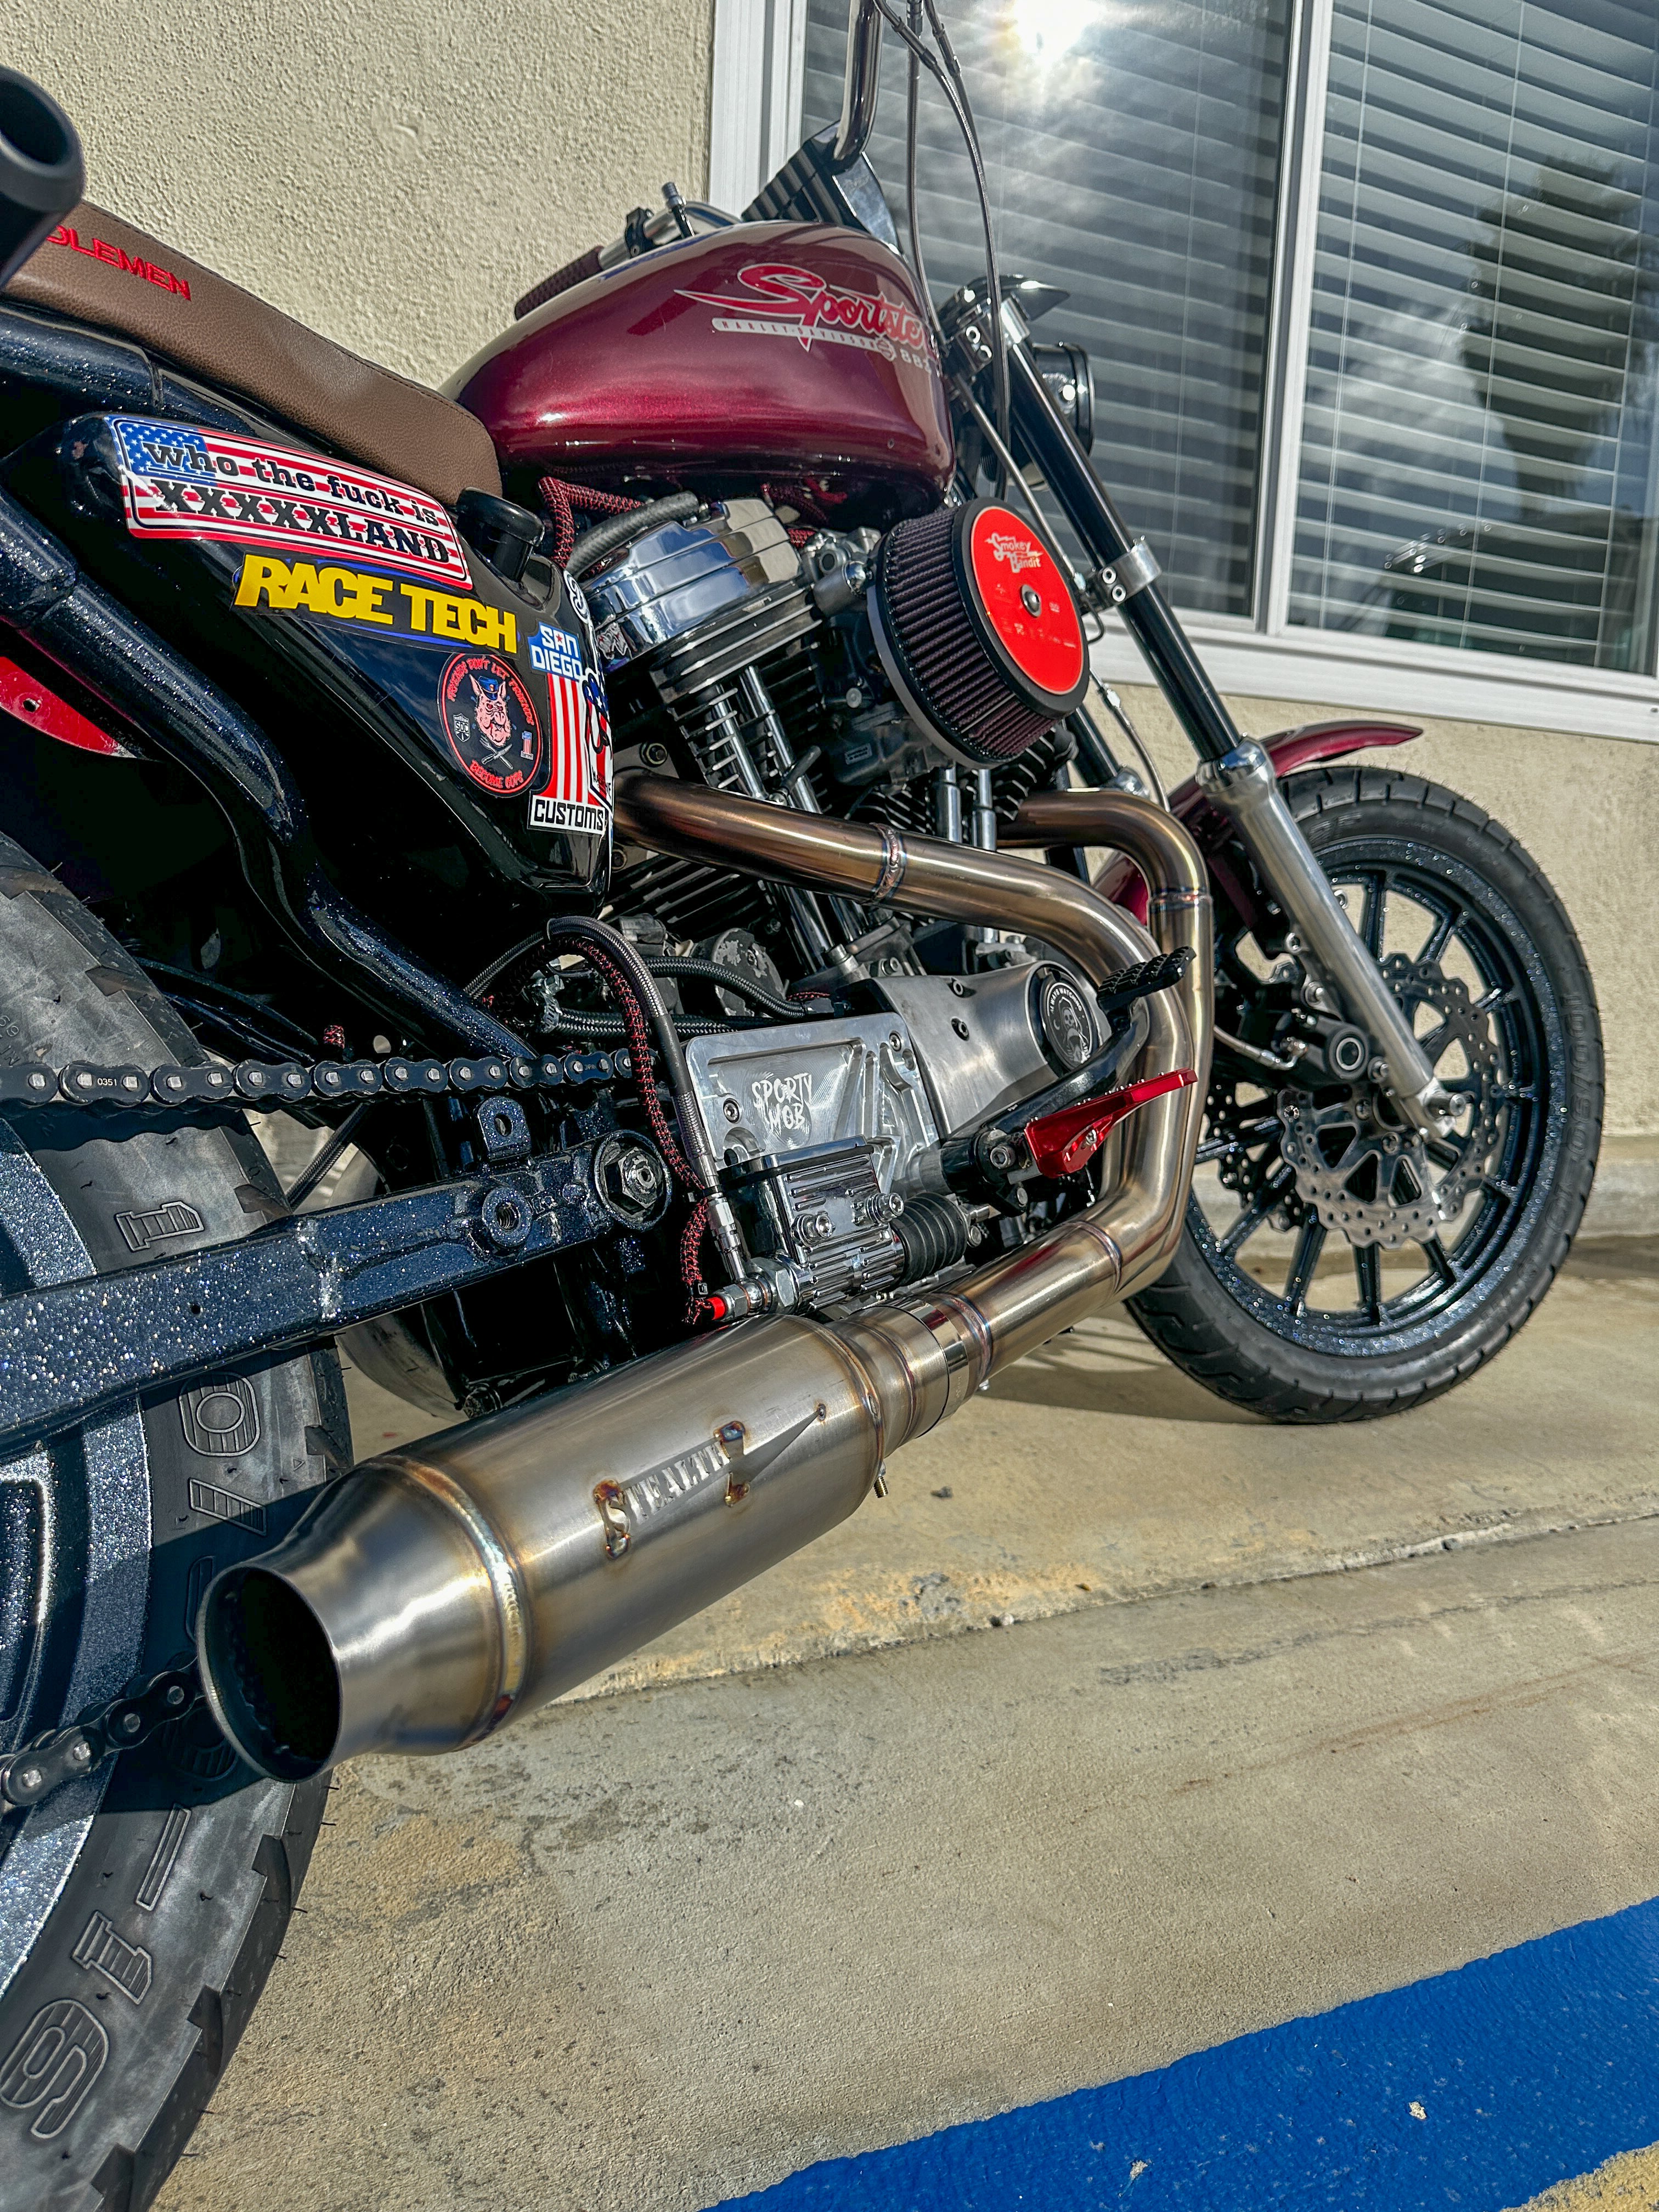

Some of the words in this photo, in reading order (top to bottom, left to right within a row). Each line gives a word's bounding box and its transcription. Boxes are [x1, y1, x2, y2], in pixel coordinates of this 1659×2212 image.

[674, 263, 933, 356] Sportste
[721, 320, 876, 349] HARLEY-DAVIDSON
[143, 441, 239, 476] who
[252, 458, 316, 492] the
[327, 476, 402, 516] fuck
[413, 500, 439, 526] is
[151, 479, 450, 563] XXXXXLAND
[984, 533, 1031, 562] Smokey
[1009, 552, 1041, 573] Bandit
[235, 555, 393, 624] RACE
[400, 582, 517, 654] TECH
[540, 624, 578, 662] SAN
[490, 662, 510, 681] LET
[531, 648, 583, 680] DIEGO
[455, 720, 470, 733] SDC
[470, 759, 504, 789] BECOME
[534, 798, 604, 831] CUSTOMS
[97, 1077, 118, 1087] 0351
[752, 1072, 812, 1109] SPORTY
[768, 1102, 805, 1134] MOB
[595, 1438, 732, 1558] STEALTH
